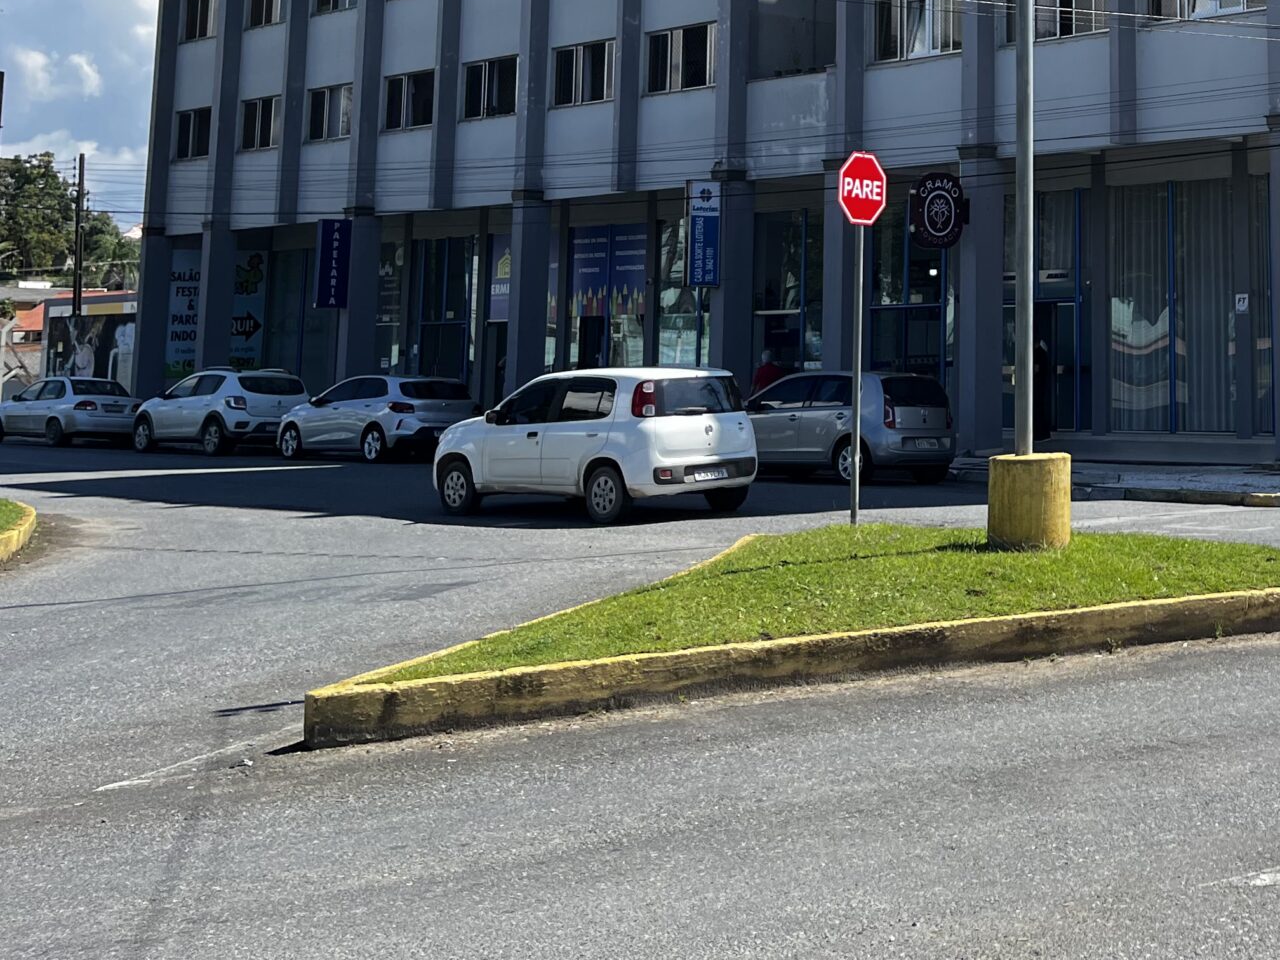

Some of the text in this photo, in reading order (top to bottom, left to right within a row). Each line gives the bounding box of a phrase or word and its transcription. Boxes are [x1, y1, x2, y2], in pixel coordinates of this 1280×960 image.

[843, 177, 882, 201] PARE
[920, 178, 960, 198] GRAMO
[694, 217, 704, 283] CASA DA SORTE LOTERIAS
[328, 222, 340, 305] PAPELARIA
[176, 286, 200, 297] FEST
[187, 299, 195, 311] &
